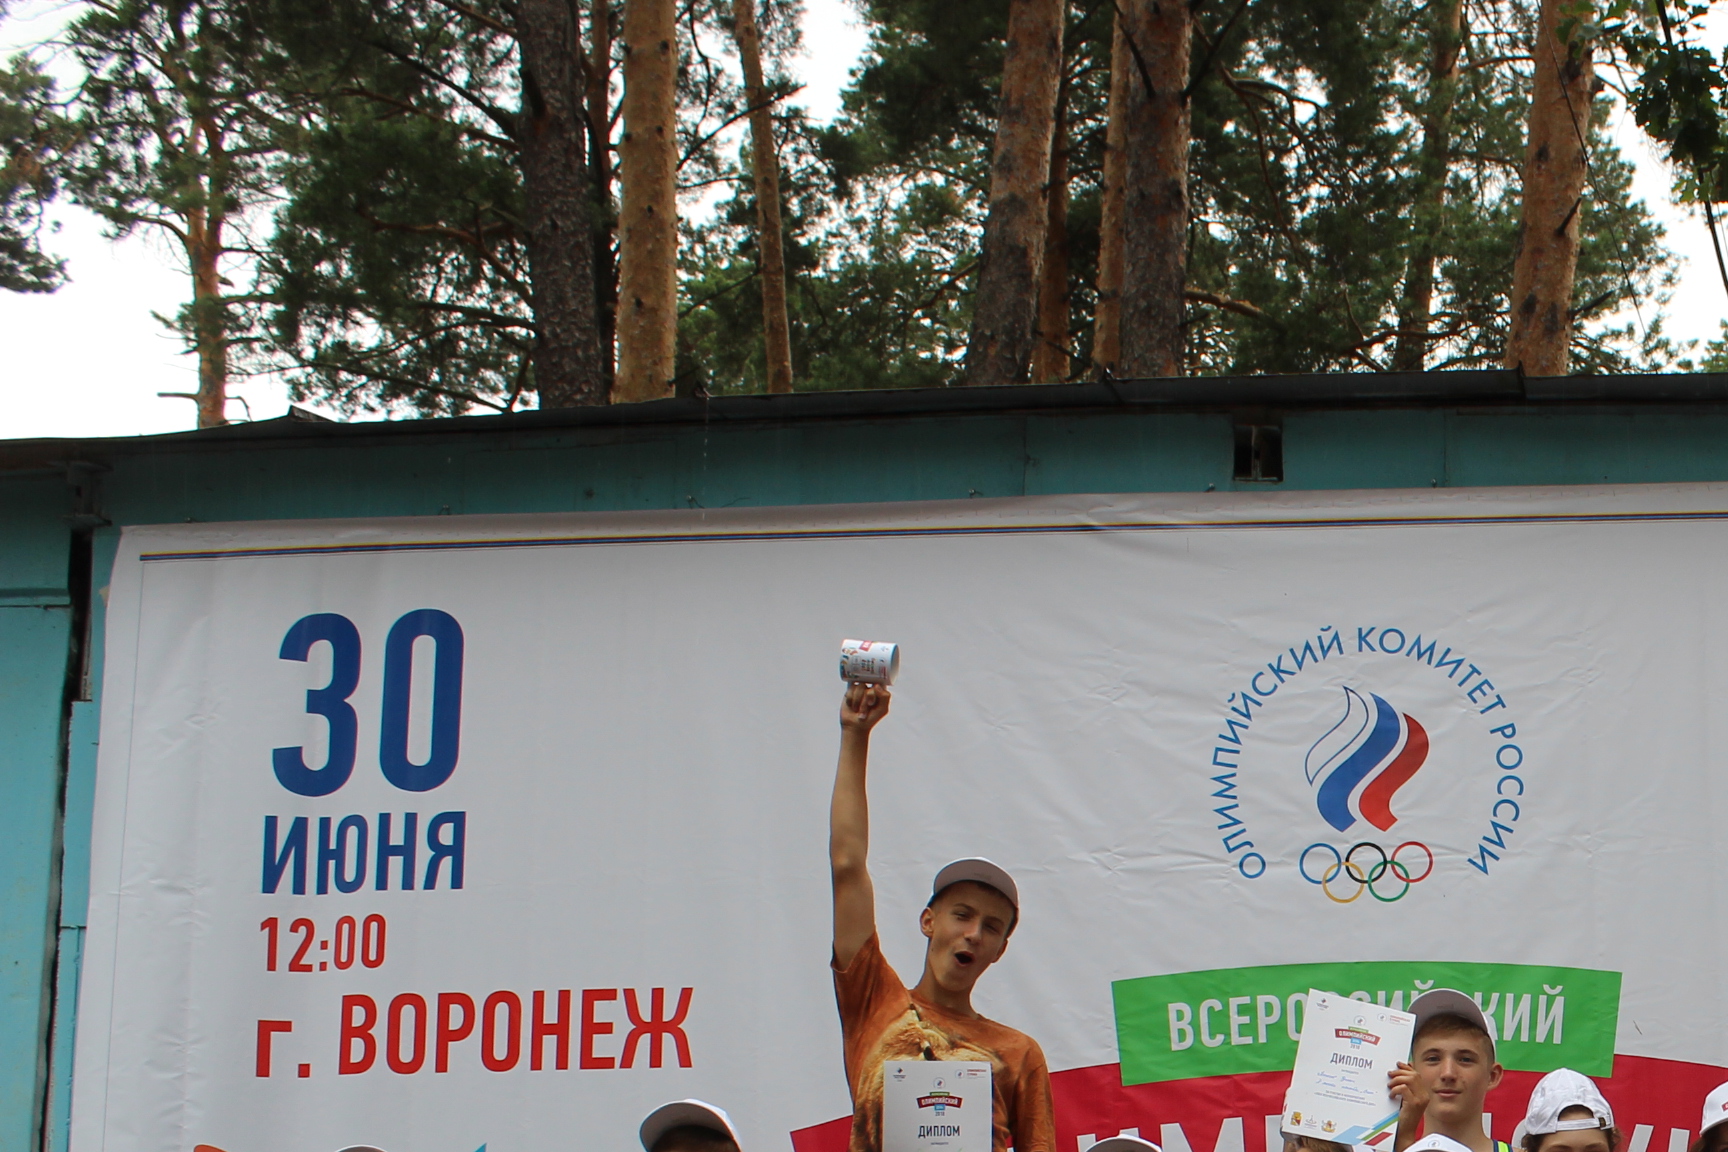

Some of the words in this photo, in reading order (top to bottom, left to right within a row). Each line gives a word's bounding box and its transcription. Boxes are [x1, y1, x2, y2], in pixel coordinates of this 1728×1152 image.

[272, 608, 464, 797] 30
[1210, 625, 1345, 879] ОЛИМПИЙСКИЙ
[1357, 626, 1507, 714] КОМИТЕТ
[1467, 722, 1524, 876] РОССИИ
[261, 810, 467, 896] ИЮНЯ
[259, 912, 387, 973] 12:00
[255, 1020, 311, 1078] г.
[338, 987, 694, 1076] ВОРОНЕЖ
[1330, 1053, 1373, 1069] ДИПЛОМ
[918, 1125, 960, 1138] ДИПЛОМ
